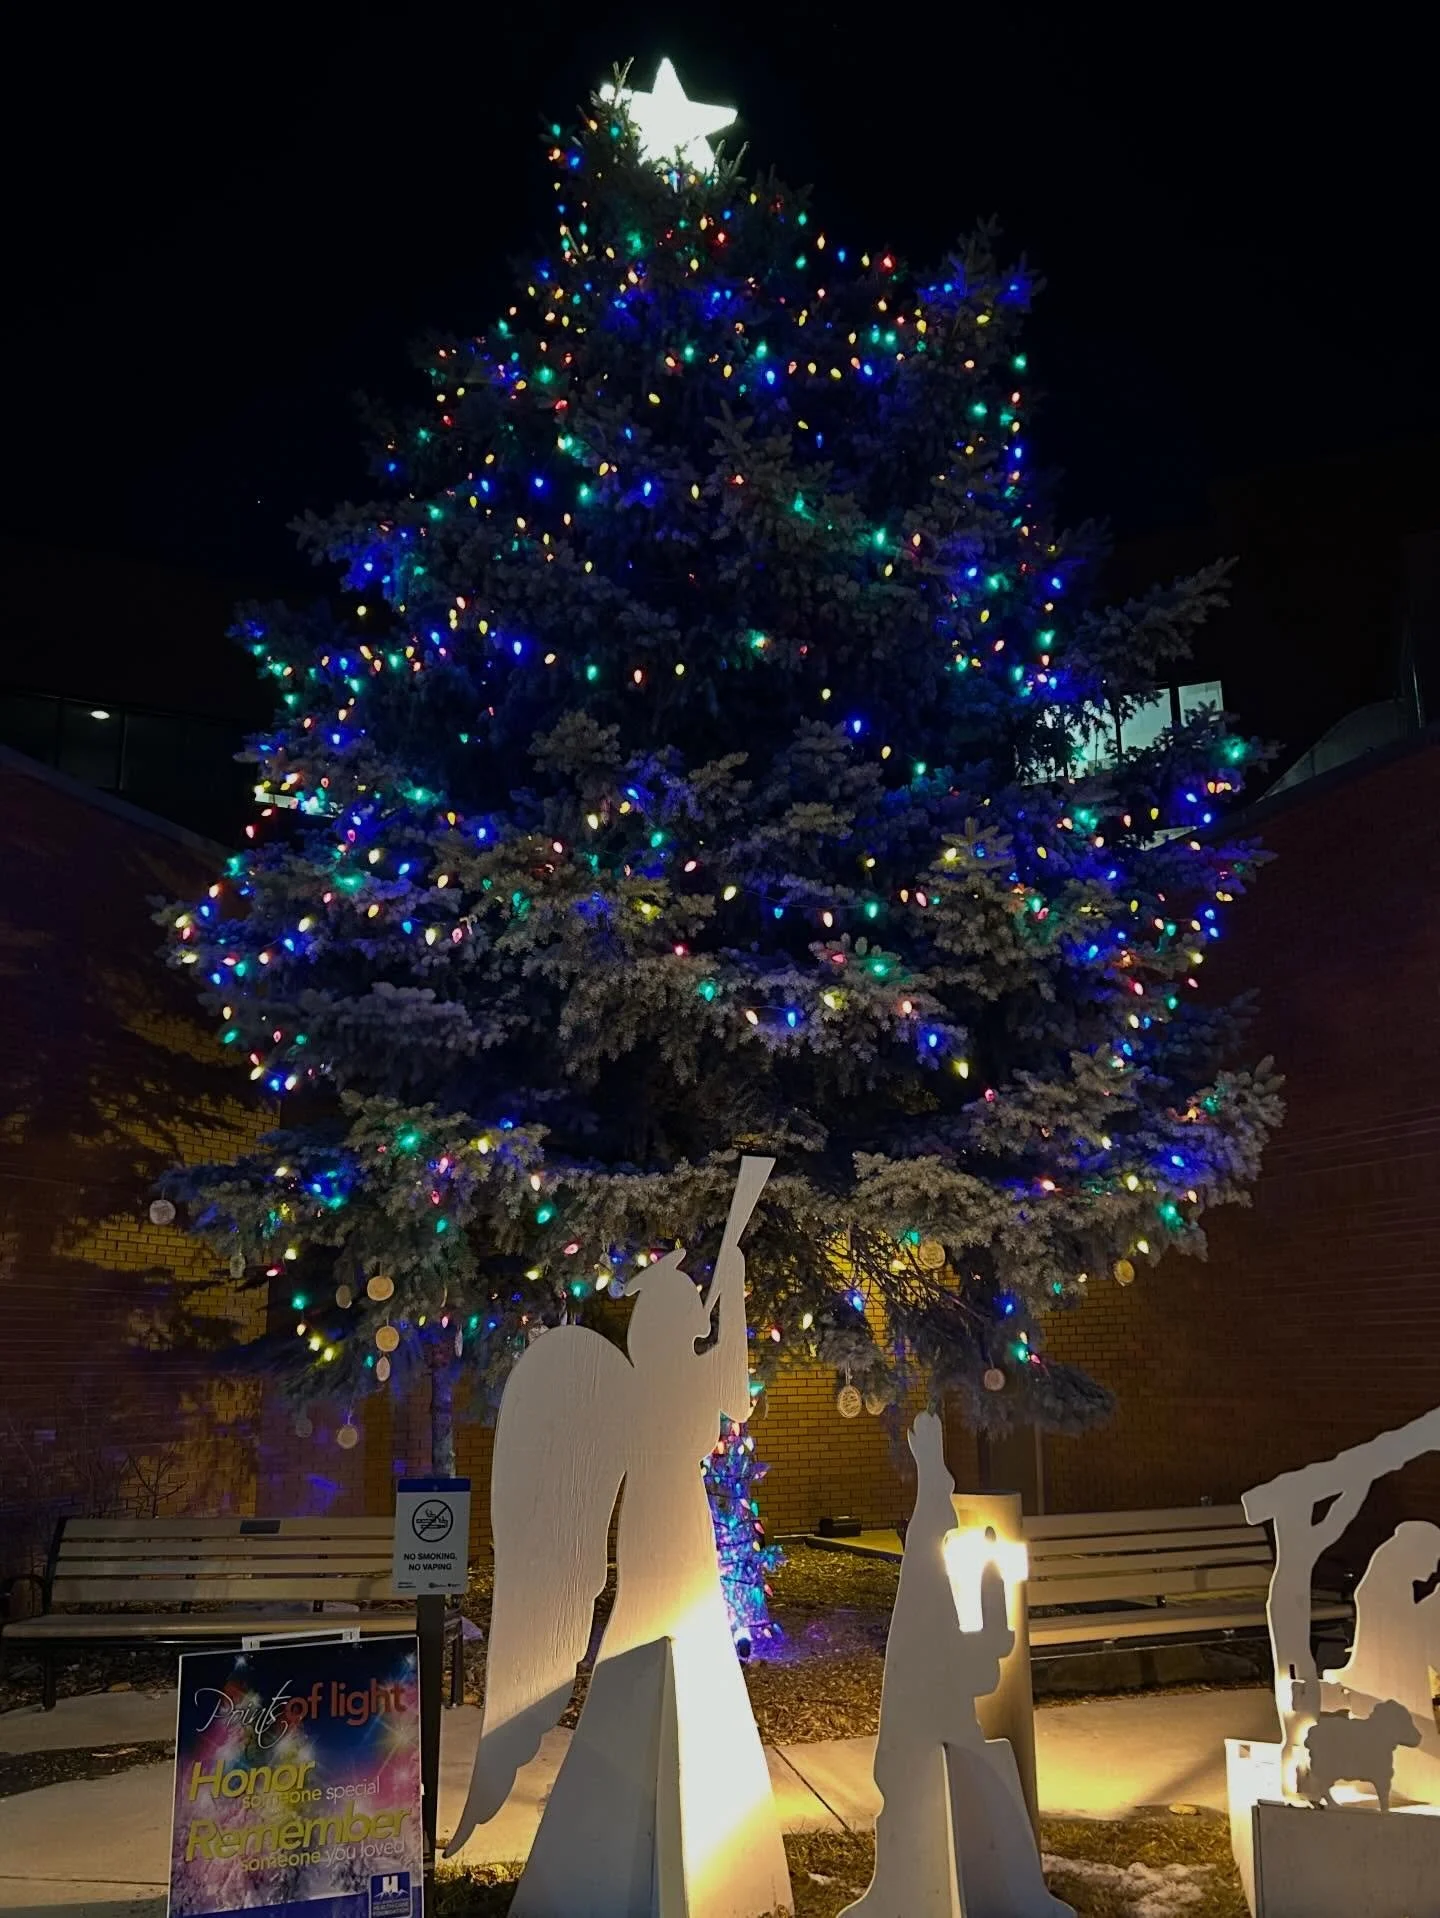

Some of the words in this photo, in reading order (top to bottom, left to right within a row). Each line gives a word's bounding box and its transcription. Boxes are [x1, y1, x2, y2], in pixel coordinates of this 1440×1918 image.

[194, 1680, 293, 1749] Points
[286, 1680, 325, 1722] of
[329, 1677, 408, 1726] light
[189, 1760, 316, 1801] Honor
[242, 1787, 322, 1809] someone
[325, 1776, 380, 1803] special
[185, 1803, 411, 1862] Remember
[240, 1852, 321, 1872] someone
[326, 1847, 356, 1868] you
[360, 1839, 405, 1857] loved
